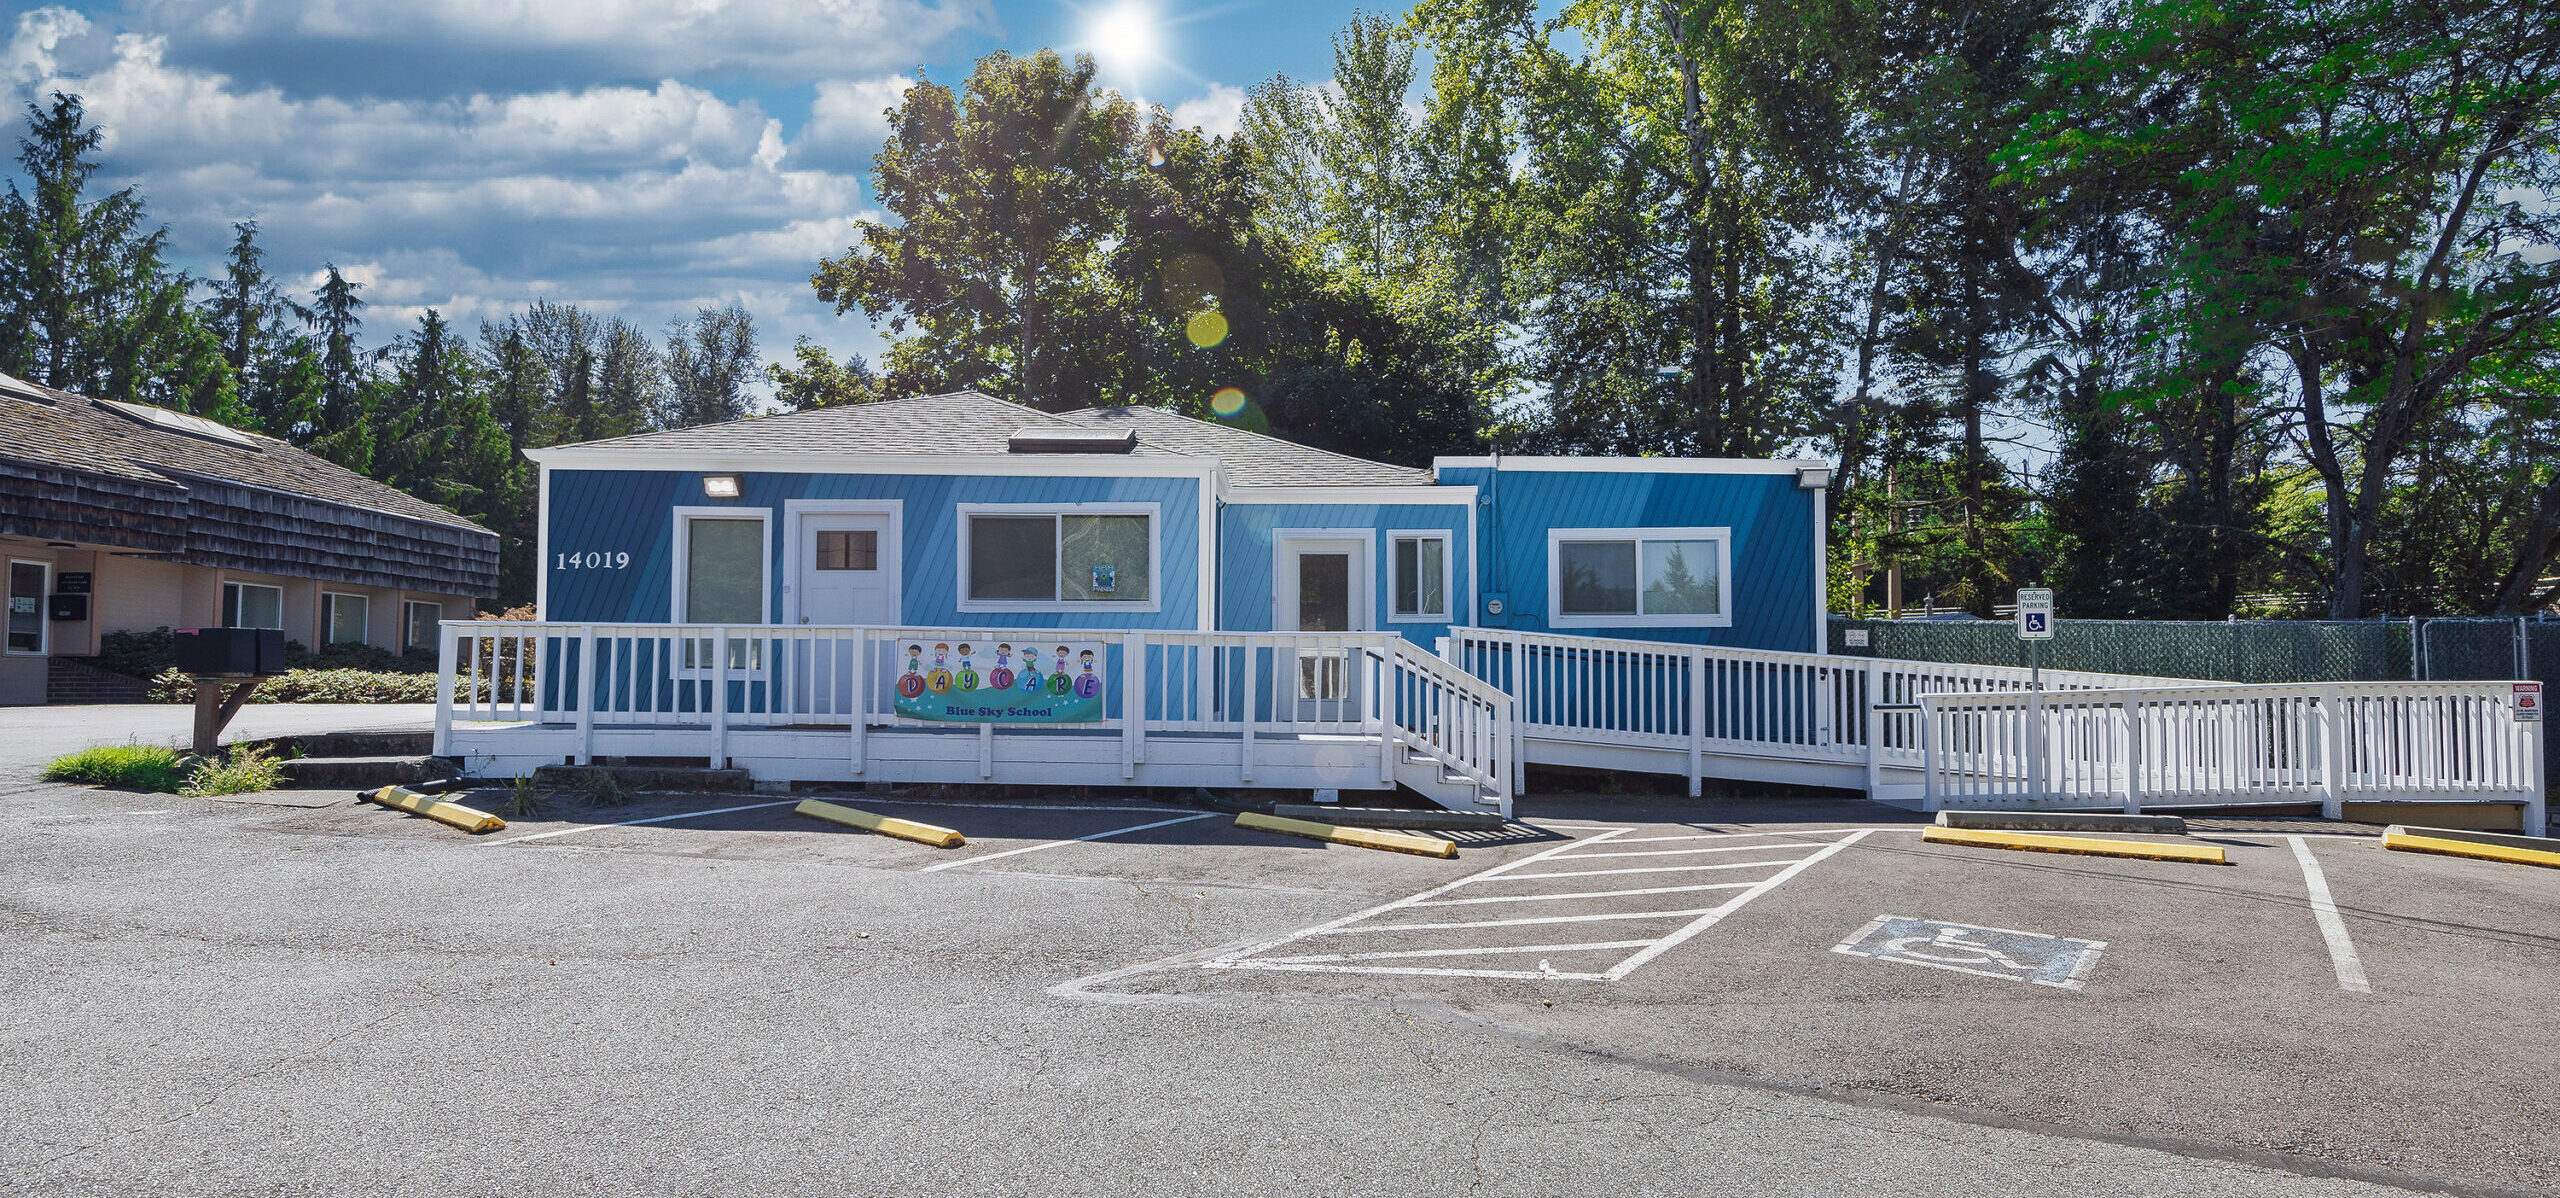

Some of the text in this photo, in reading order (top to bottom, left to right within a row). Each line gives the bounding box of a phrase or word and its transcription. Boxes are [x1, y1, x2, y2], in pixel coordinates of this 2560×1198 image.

[556, 551, 630, 570] 14019
[2020, 593, 2050, 601] RESERVED
[945, 706, 1052, 718] Blue Sky School
